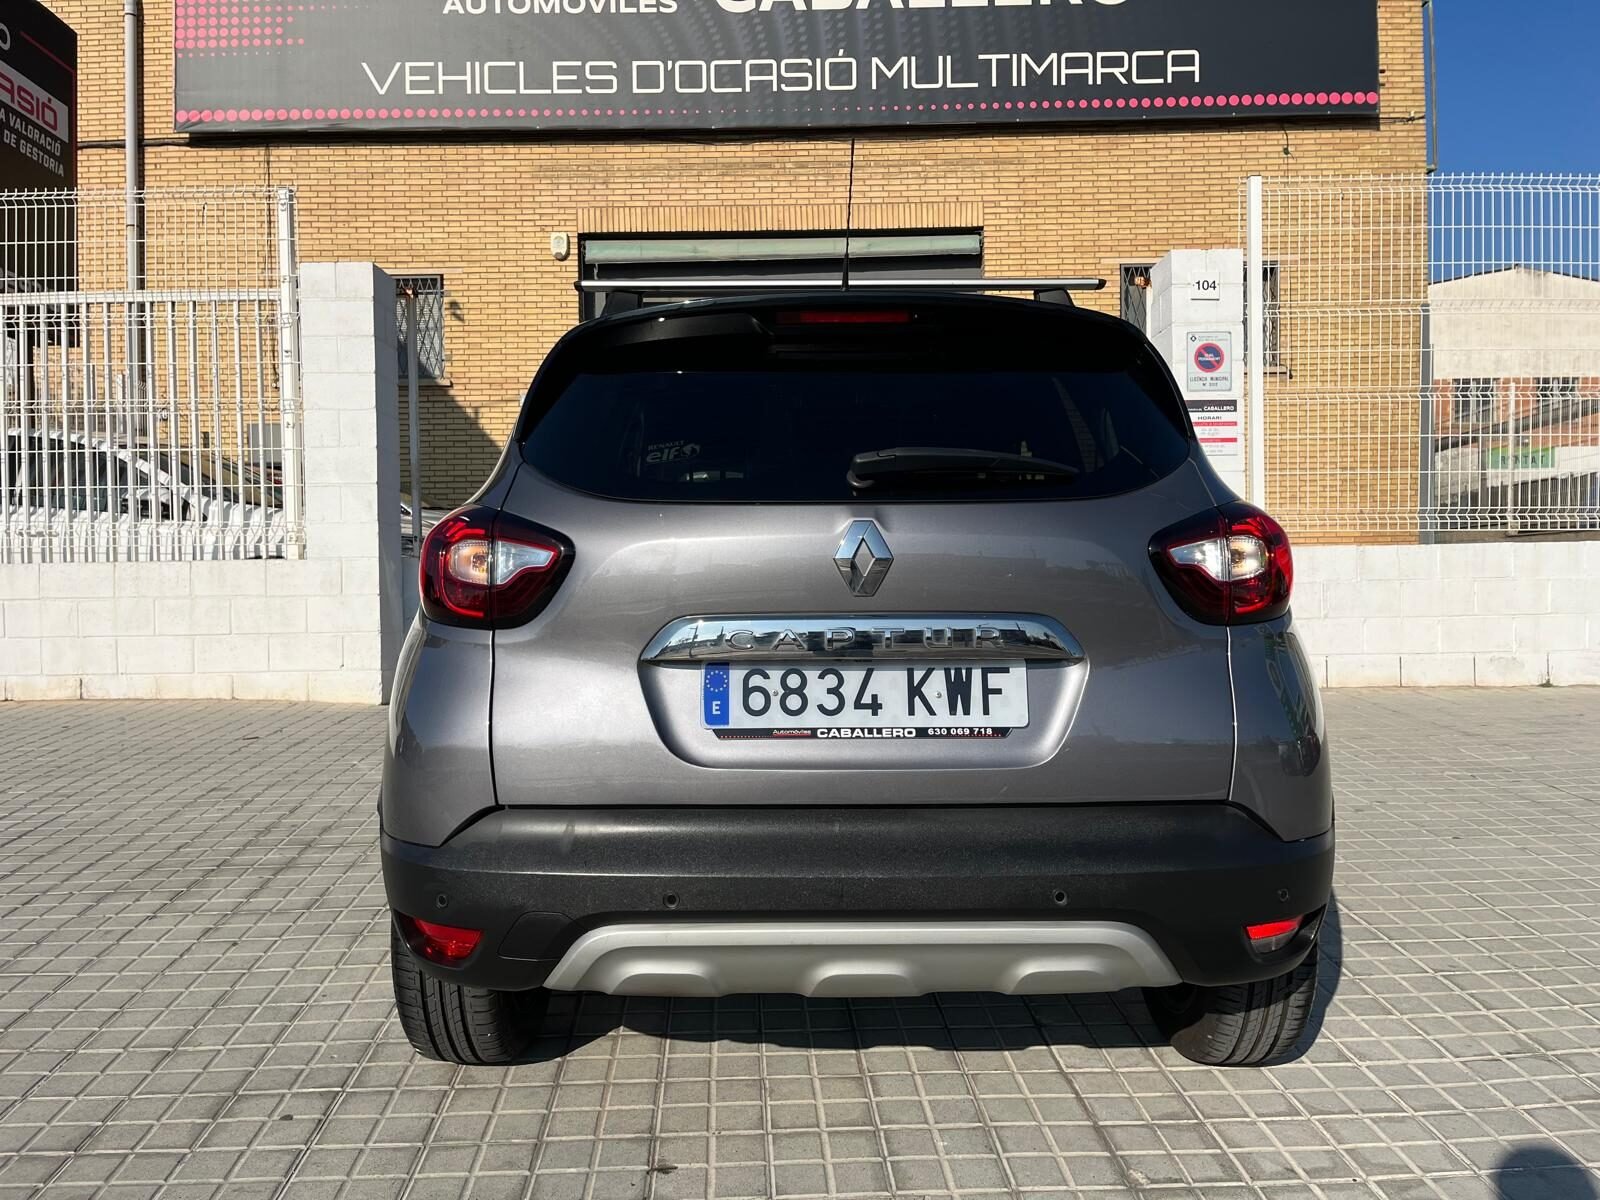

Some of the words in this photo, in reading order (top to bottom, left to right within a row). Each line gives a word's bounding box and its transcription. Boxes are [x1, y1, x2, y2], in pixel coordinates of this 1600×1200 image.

[361, 60, 618, 95] VEHICLES
[632, 48, 857, 94] D'OCASIÓ
[871, 49, 1200, 90] MULTIMARCA
[9, 112, 61, 156] VALORACIÓ
[4, 129, 17, 148] DE
[20, 139, 64, 177] GESTORIA
[1195, 280, 1217, 291] 104
[646, 446, 681, 463] elf
[726, 627, 1004, 651] CAPTUR
[741, 667, 883, 717] 6834
[906, 667, 1011, 717] KWF
[712, 701, 721, 715] E
[816, 728, 916, 738] CABALLERO
[927, 727, 948, 735] 630
[950, 727, 970, 735] 069
[973, 727, 993, 735] 718
